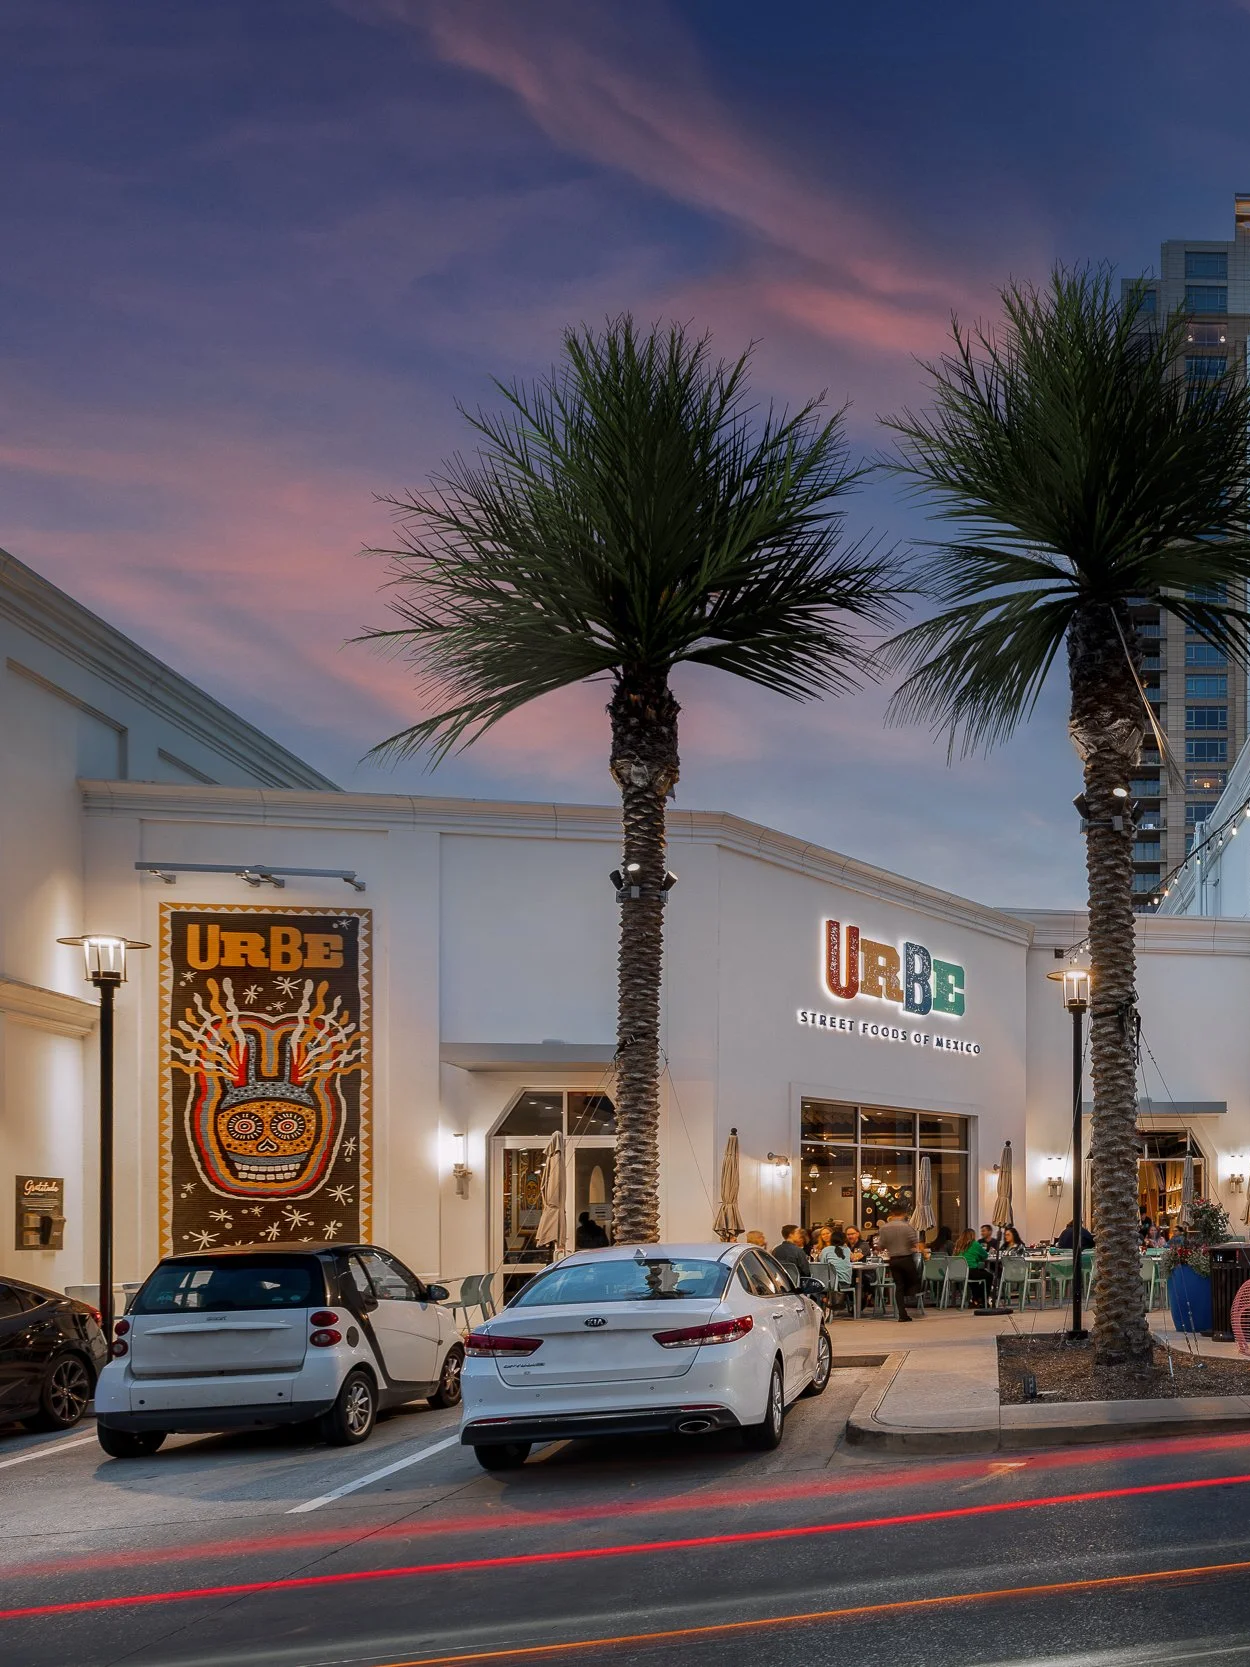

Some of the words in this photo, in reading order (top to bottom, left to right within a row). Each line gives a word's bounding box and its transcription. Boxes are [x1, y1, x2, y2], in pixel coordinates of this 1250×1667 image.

[800, 1011, 855, 1031] STREET
[862, 1023, 908, 1041] FOODS
[914, 1033, 930, 1045] OF
[935, 1037, 981, 1054] MEXICO
